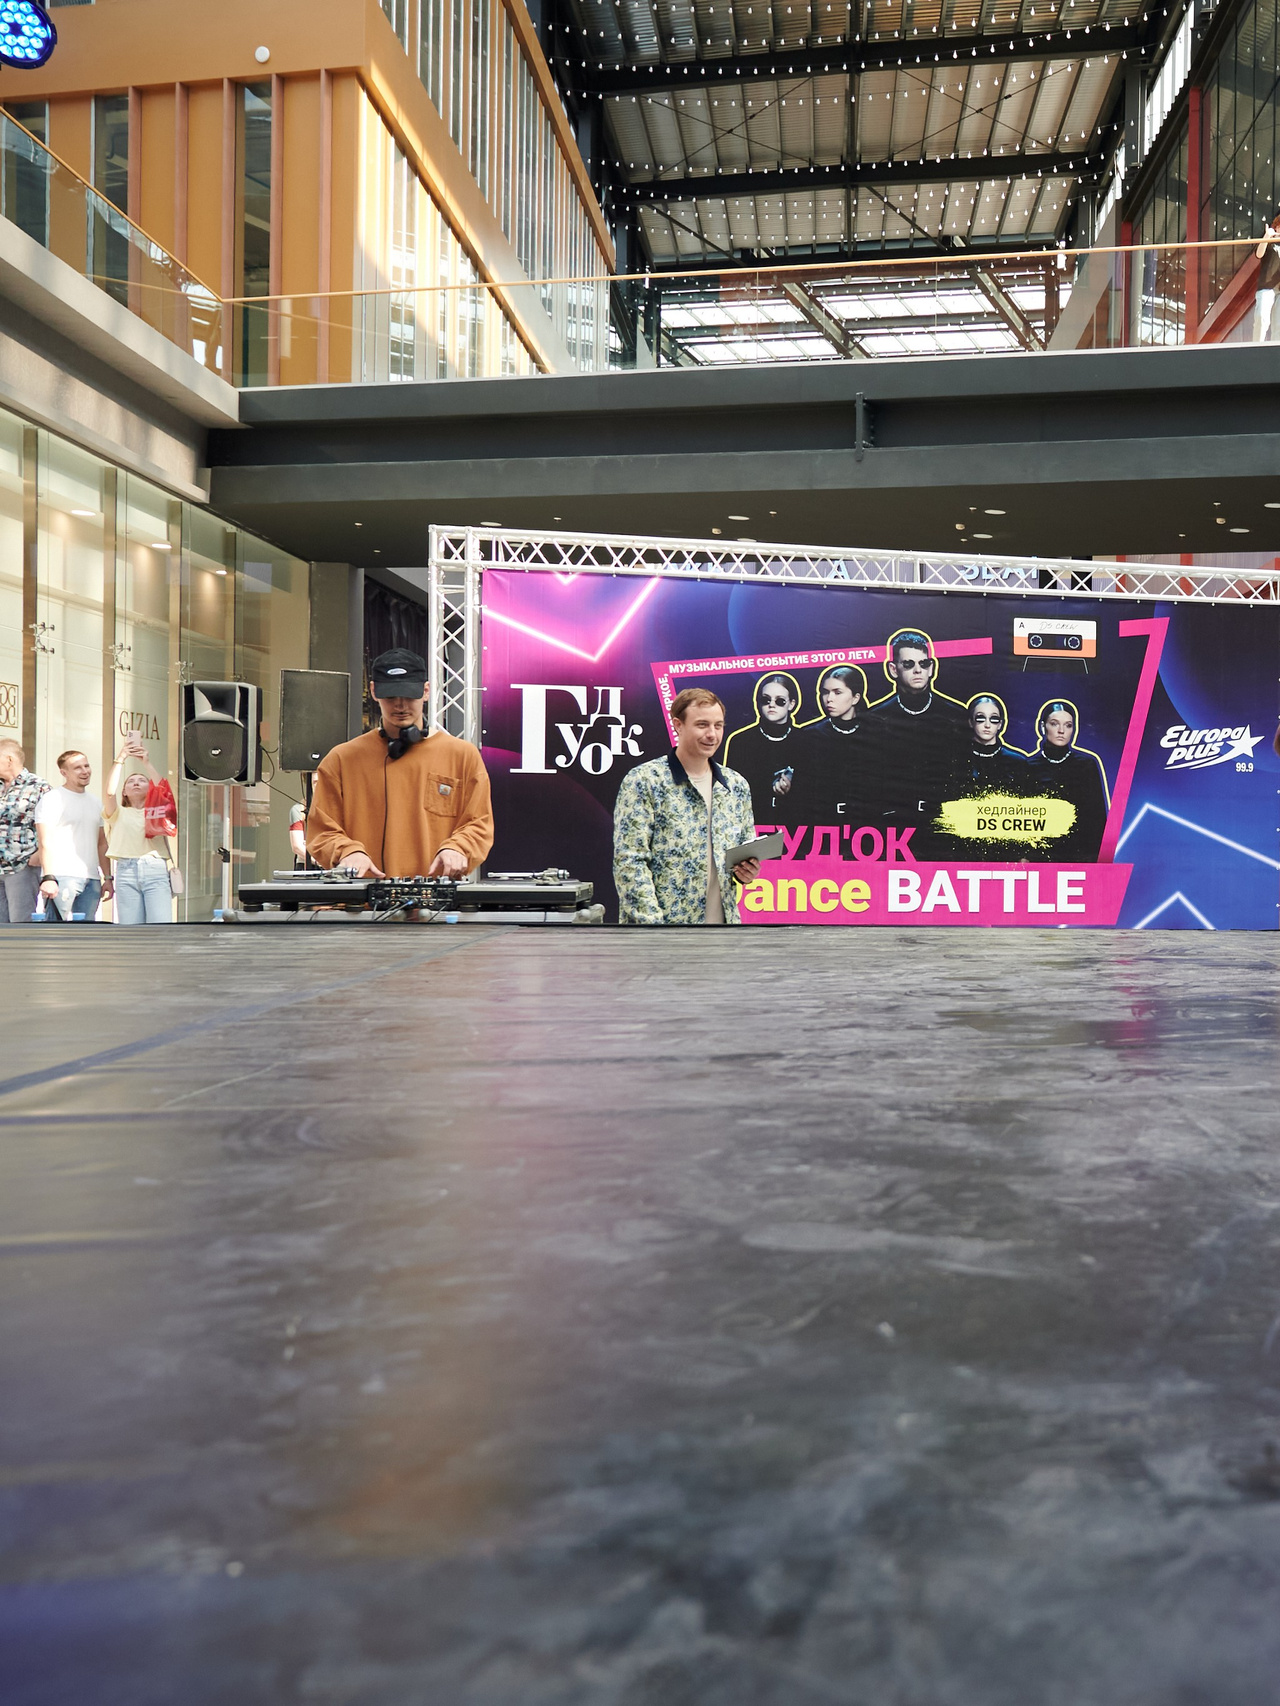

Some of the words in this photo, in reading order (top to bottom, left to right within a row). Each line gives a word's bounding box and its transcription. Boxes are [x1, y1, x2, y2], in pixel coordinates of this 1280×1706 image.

[1019, 621, 1025, 629] A
[668, 658, 755, 674] МУЗЫКАЛЬНОЕ
[756, 654, 809, 668] СОБЫТИЕ
[811, 651, 846, 663] ЭТОГО
[847, 649, 876, 661] ЛЕТА
[1235, 762, 1254, 772] 99.9
[976, 804, 1047, 818] хедлайнер
[976, 818, 997, 831] DS
[1001, 819, 1046, 832] CREW
[733, 876, 872, 913] ance
[887, 869, 1086, 913] BATTLE
